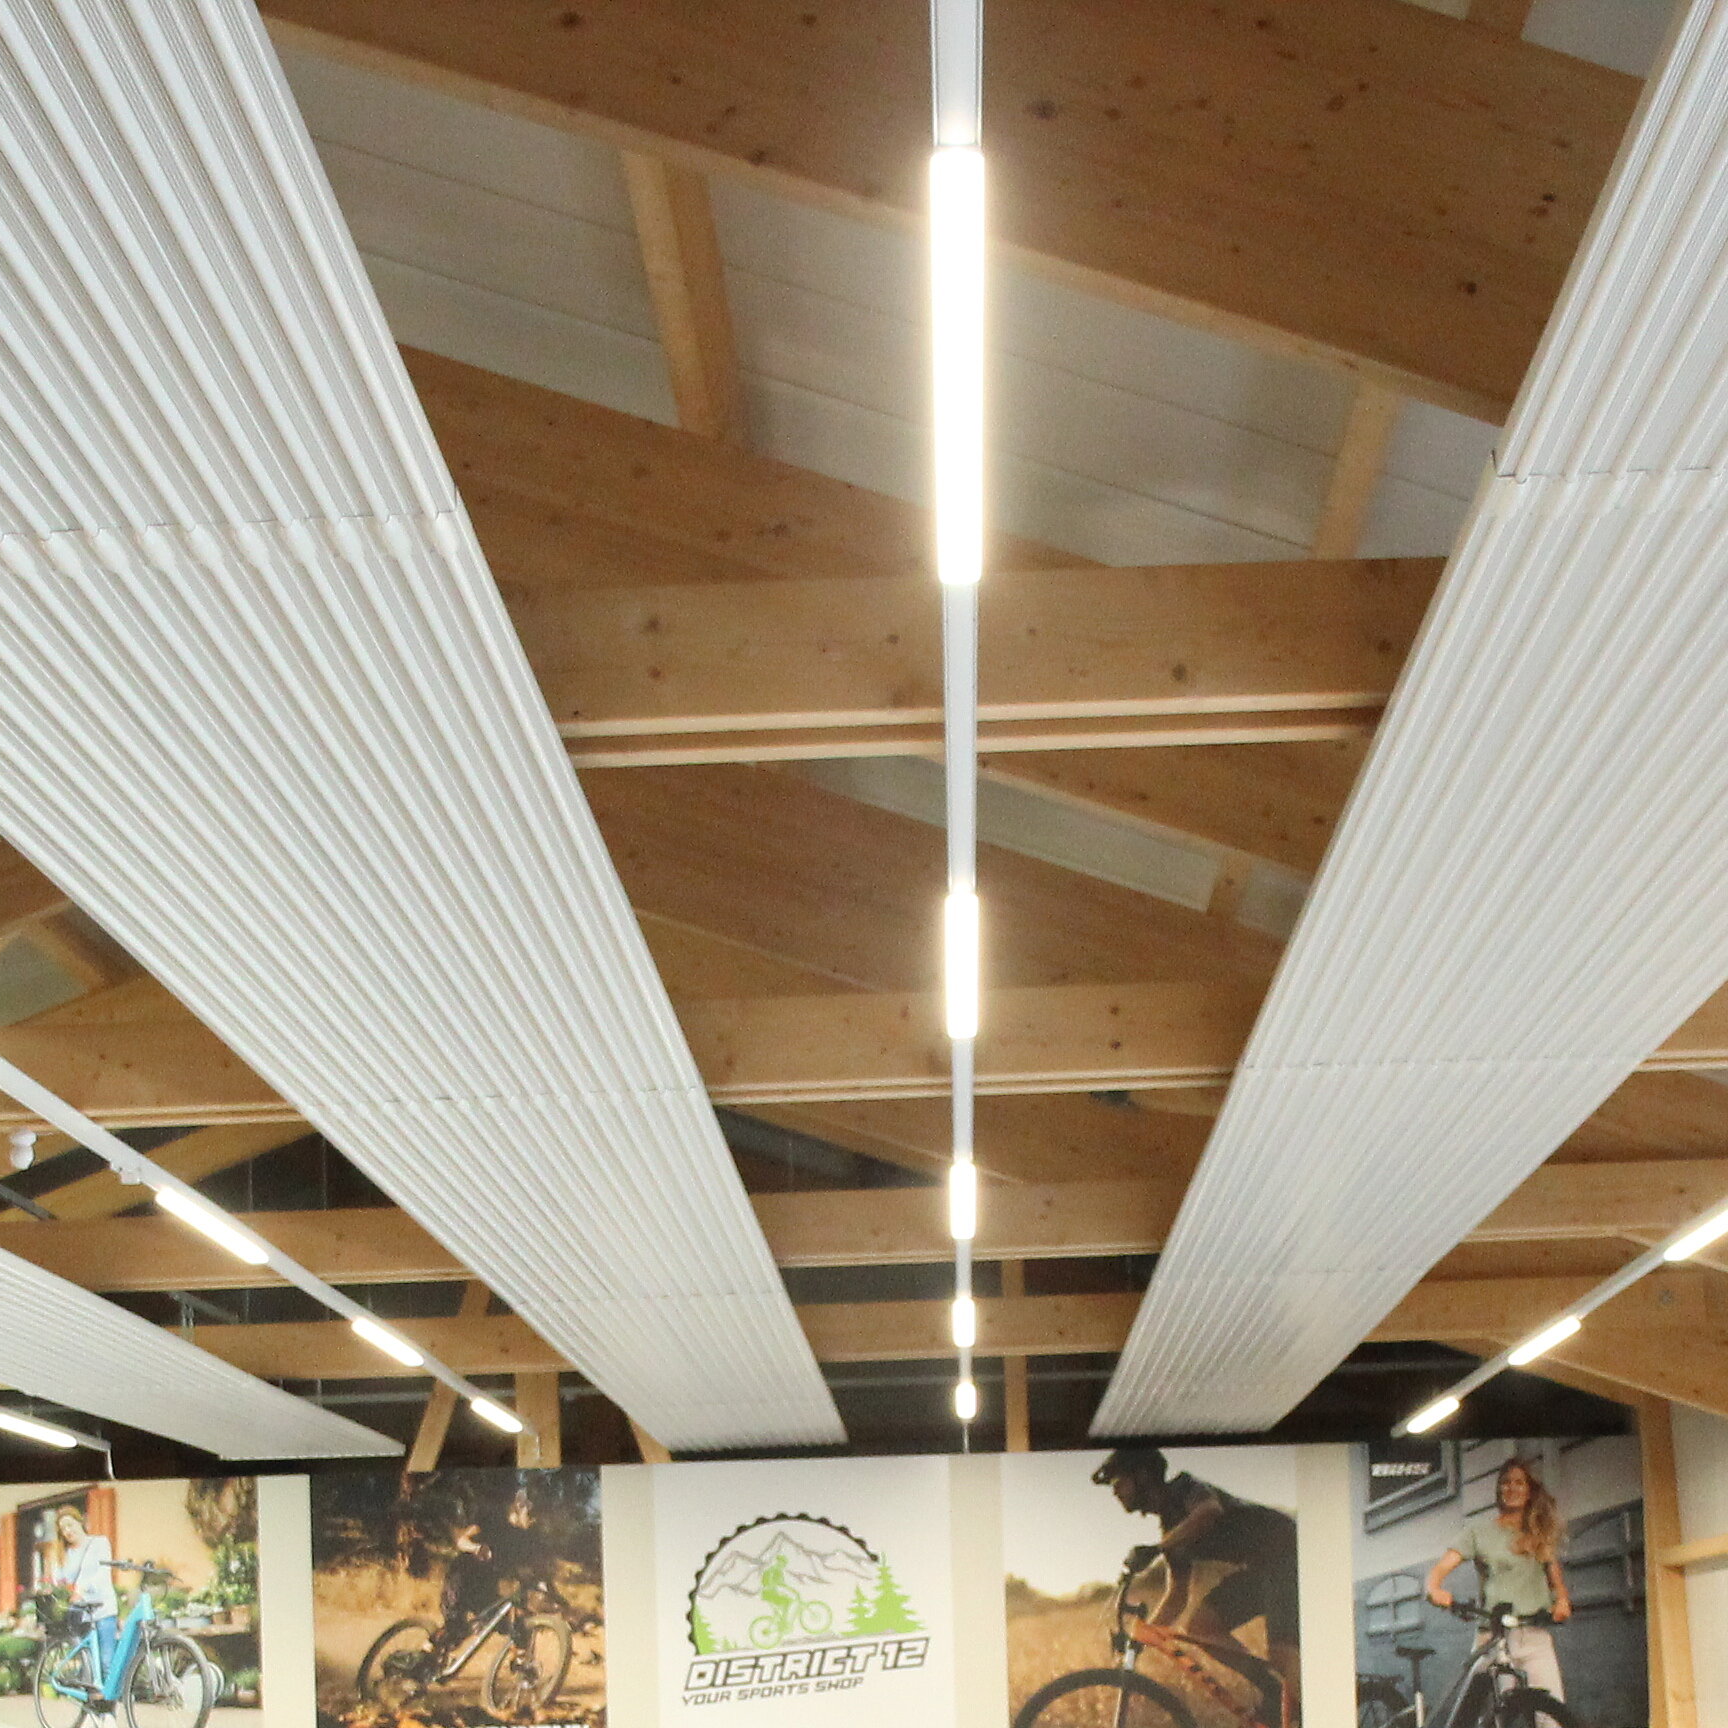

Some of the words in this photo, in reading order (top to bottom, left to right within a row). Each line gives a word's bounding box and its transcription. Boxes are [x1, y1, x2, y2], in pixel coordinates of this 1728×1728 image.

[684, 1643, 879, 1692] DISTRICT
[881, 1636, 931, 1671] 12
[682, 1690, 731, 1706] YOUR
[737, 1682, 810, 1701] SPORTS
[815, 1676, 864, 1692] SHOP
